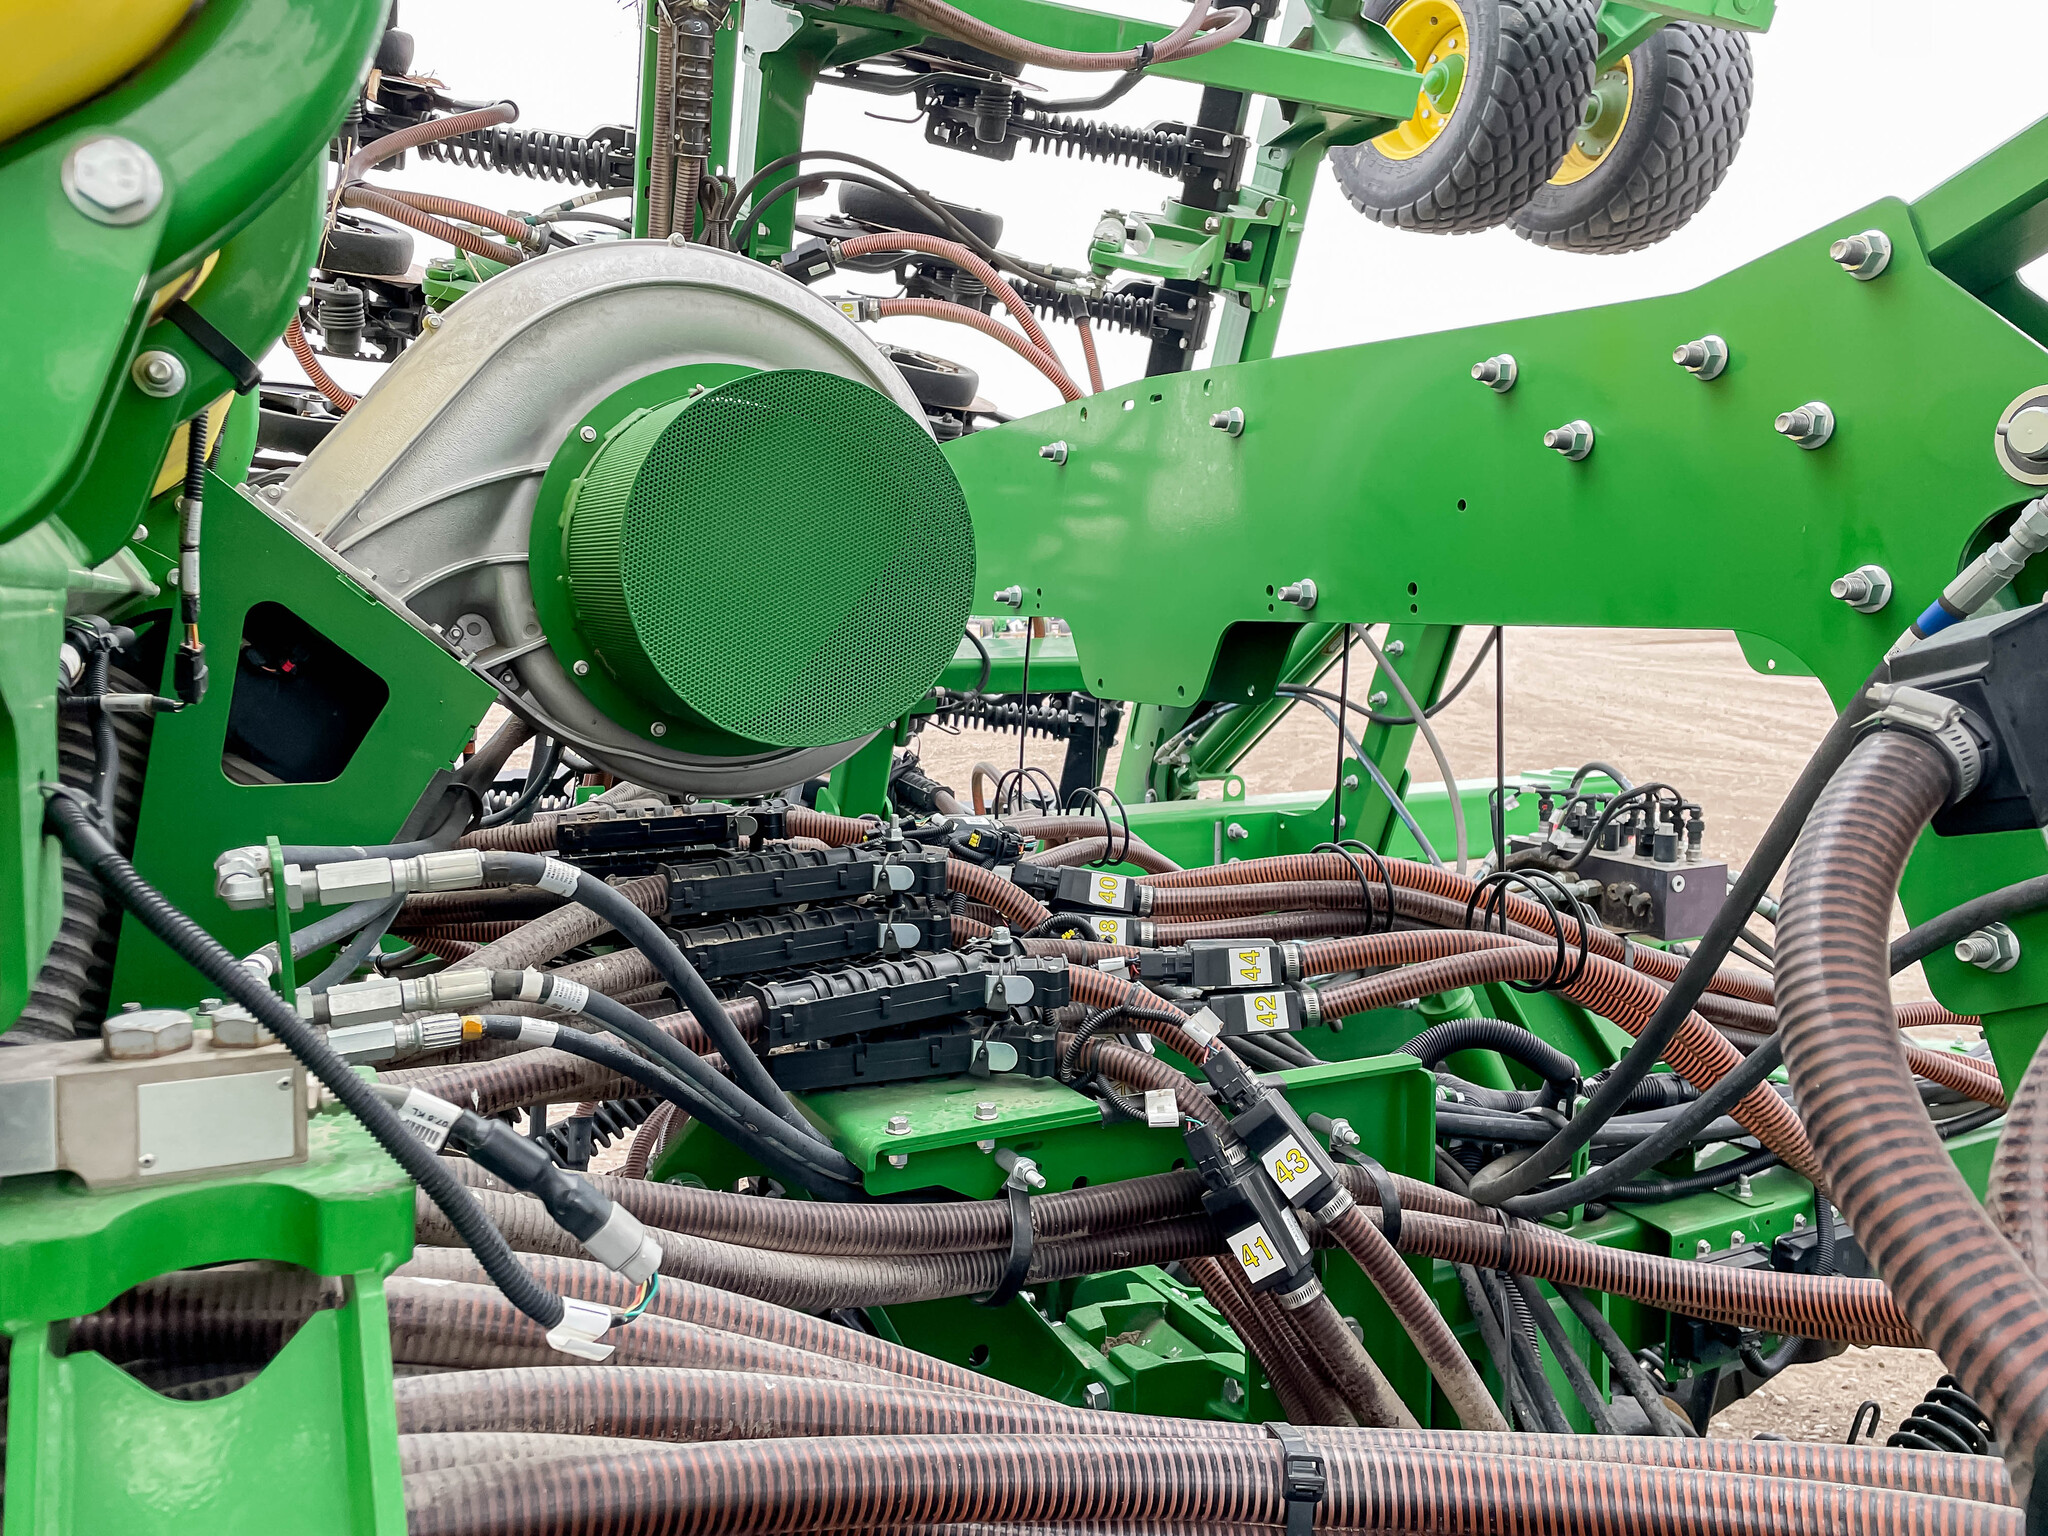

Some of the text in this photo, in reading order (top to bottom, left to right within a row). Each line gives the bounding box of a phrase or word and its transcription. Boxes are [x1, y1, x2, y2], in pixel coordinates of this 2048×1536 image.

[693, 21, 703, 32] 3
[841, 303, 855, 319] 0
[1098, 876, 1118, 904] 40
[1238, 949, 1262, 982] 44
[1254, 994, 1278, 1028] 42
[1275, 1148, 1310, 1184] 43
[1241, 1235, 1273, 1267] 41
